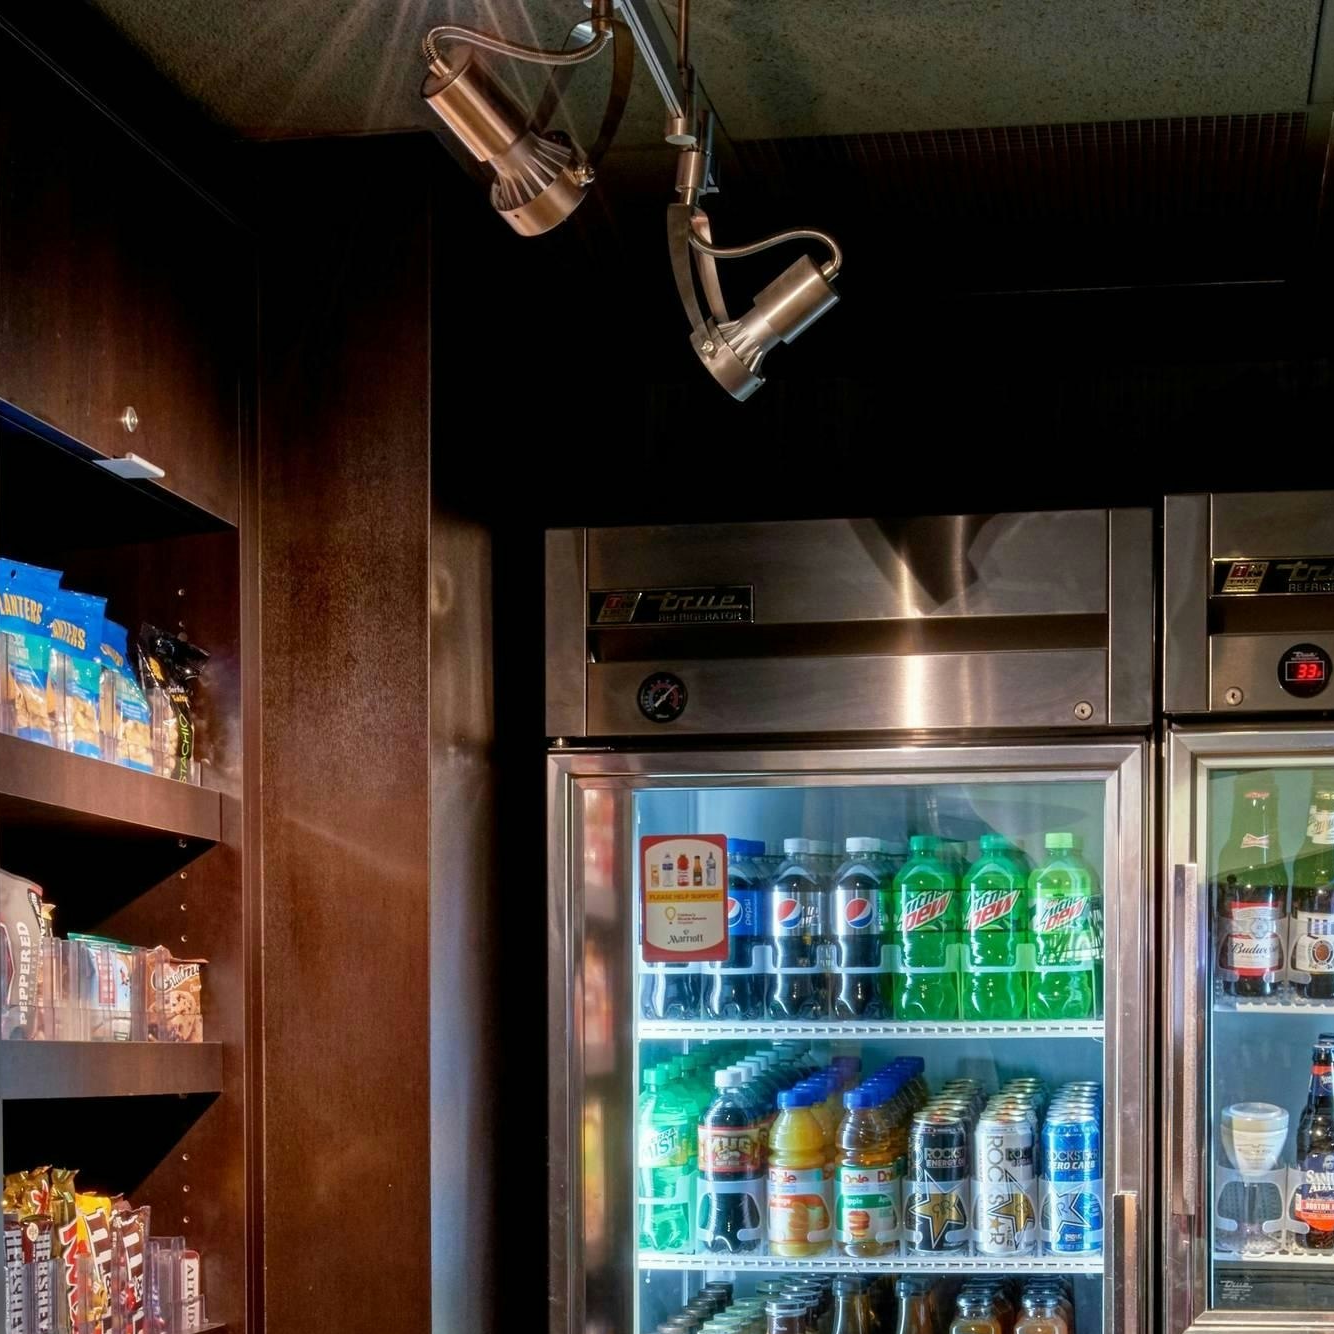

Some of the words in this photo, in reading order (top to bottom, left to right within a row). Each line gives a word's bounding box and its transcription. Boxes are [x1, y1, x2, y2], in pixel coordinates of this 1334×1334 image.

[658, 611, 742, 622] REFRIGERATOR
[1296, 663, 1318, 679] 33
[667, 933, 704, 945] Marriott
[16, 921, 32, 1025] PEPPERED
